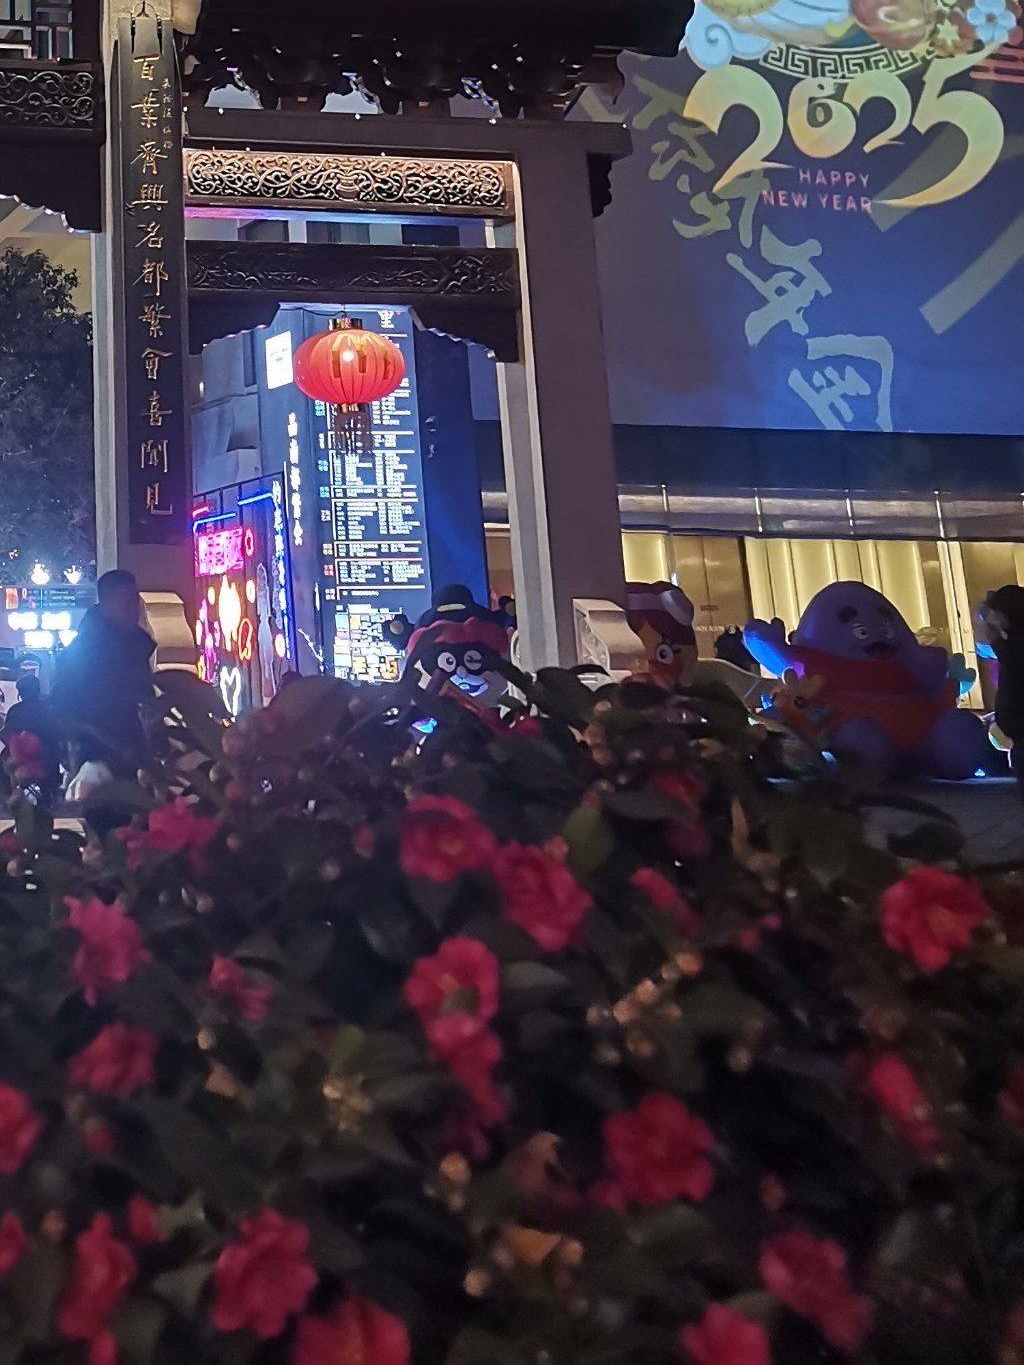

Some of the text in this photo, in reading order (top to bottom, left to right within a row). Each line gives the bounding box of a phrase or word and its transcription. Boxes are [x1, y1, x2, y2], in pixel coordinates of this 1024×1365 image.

[799, 169, 869, 188] HAPPY
[762, 190, 872, 213] NEW YEAR
